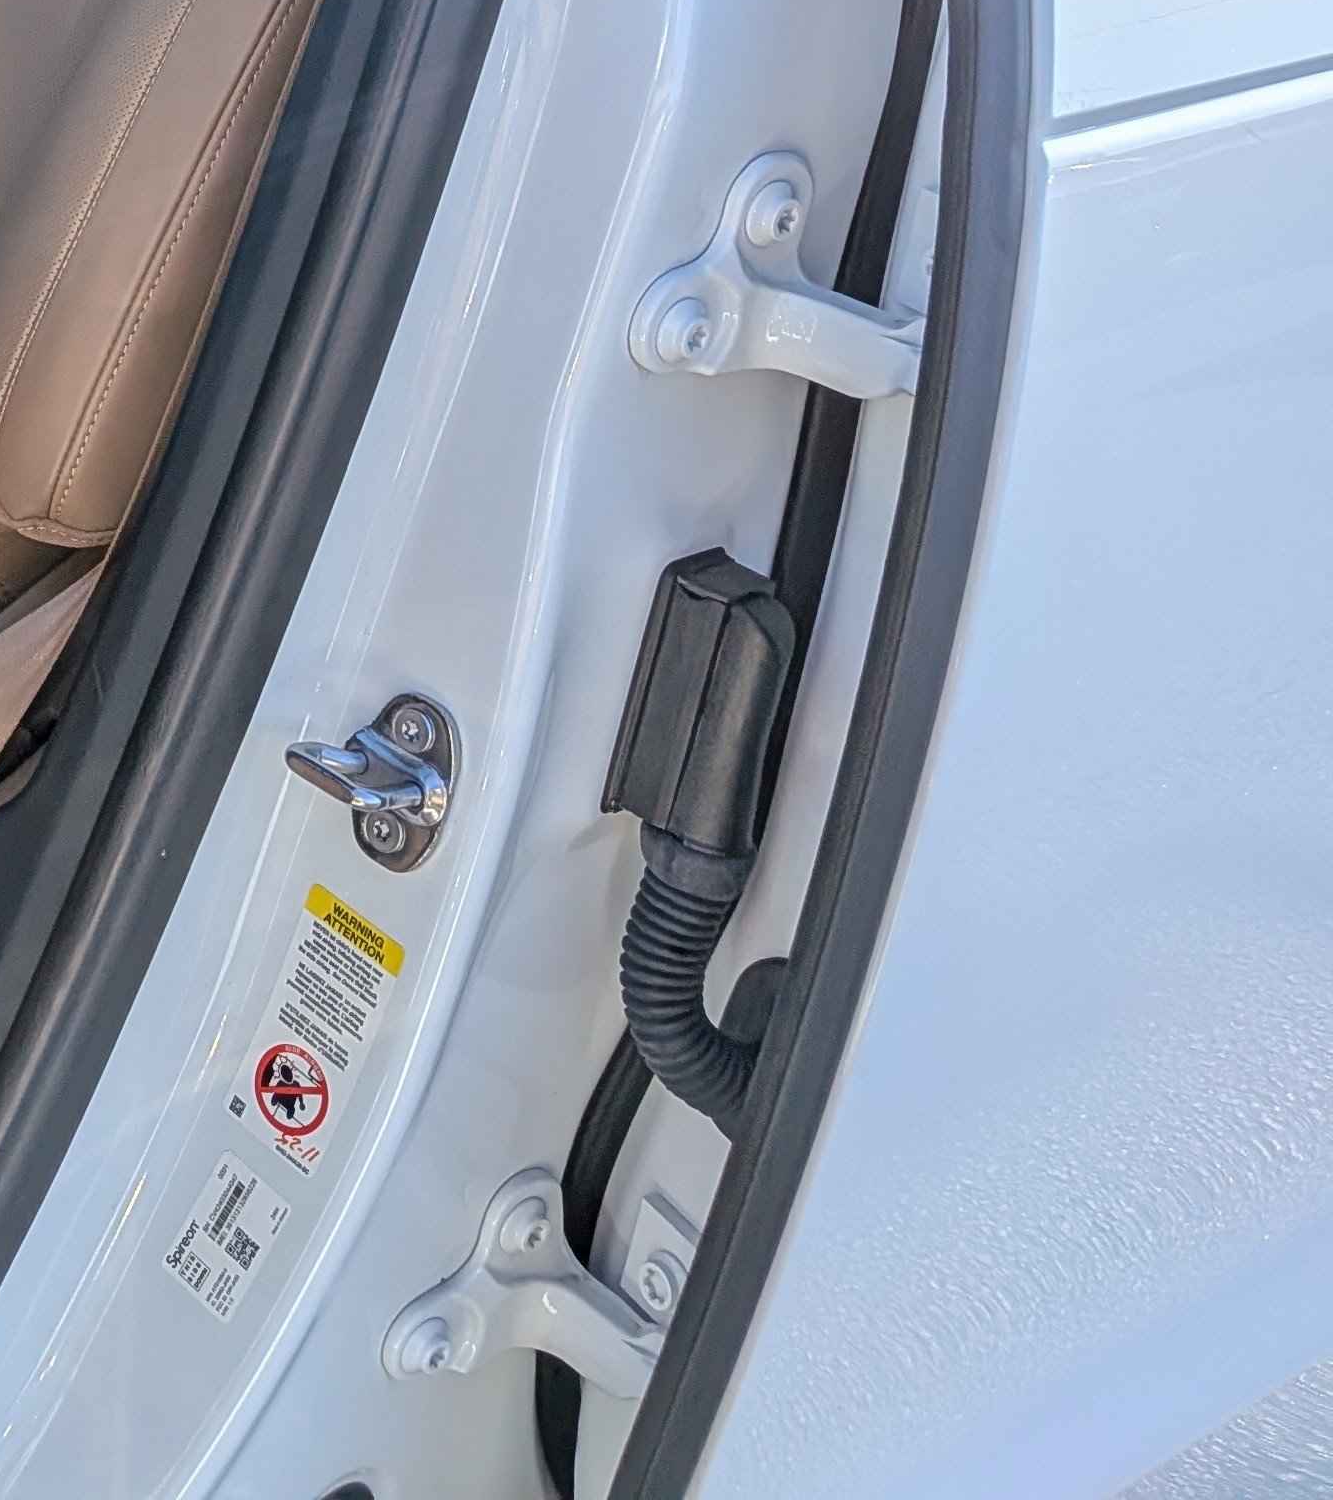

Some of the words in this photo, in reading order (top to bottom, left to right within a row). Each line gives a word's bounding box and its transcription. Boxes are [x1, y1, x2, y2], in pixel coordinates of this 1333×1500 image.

[323, 914, 384, 964] ATTENTION
[334, 903, 384, 949] WARNING
[166, 1221, 199, 1268] Spireon
[194, 1268, 208, 1288] DOWN
